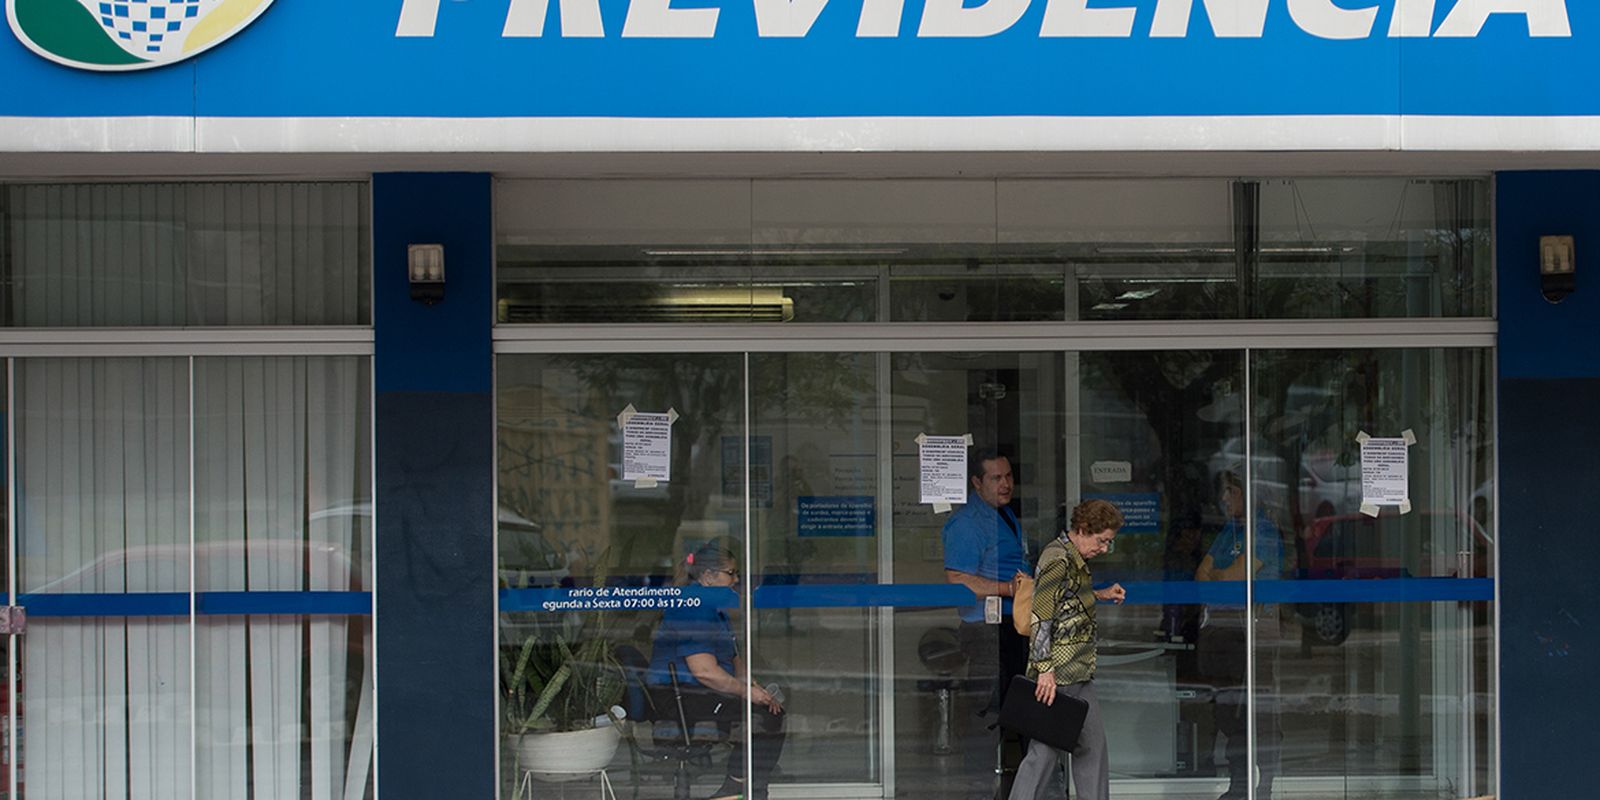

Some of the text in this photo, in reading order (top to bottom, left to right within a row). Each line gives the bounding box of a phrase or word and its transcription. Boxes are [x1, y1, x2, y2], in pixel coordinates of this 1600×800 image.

[809, 502, 839, 510] portadores
[848, 502, 872, 510] aparelho
[568, 587, 682, 597] rario de Atendimento
[542, 600, 583, 612] egunda
[592, 599, 621, 609] Sexta
[623, 599, 655, 608] 07:00
[669, 597, 701, 607] 17:00
